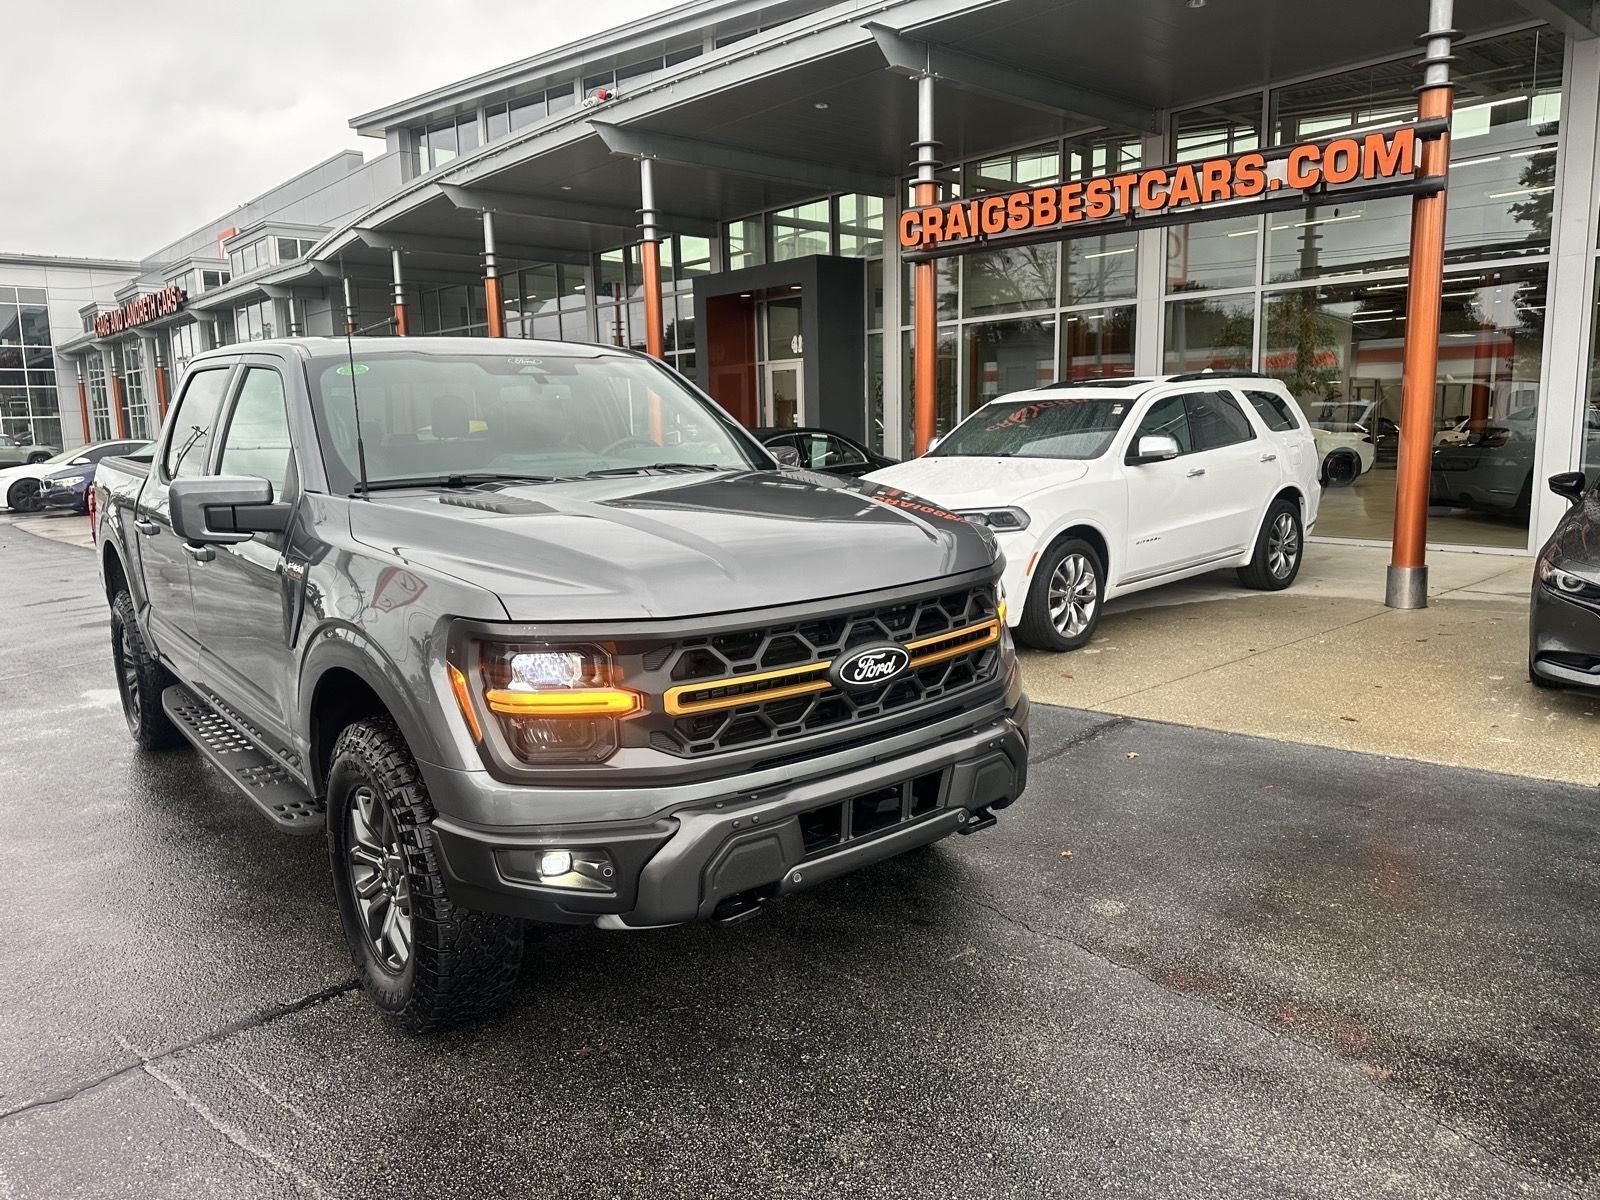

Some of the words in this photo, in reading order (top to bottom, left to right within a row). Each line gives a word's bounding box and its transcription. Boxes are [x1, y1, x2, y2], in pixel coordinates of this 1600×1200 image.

[900, 128, 1415, 247] CRAIGSBESTCARS.COM
[157, 286, 177, 316] CARS
[854, 653, 896, 680] Ford
